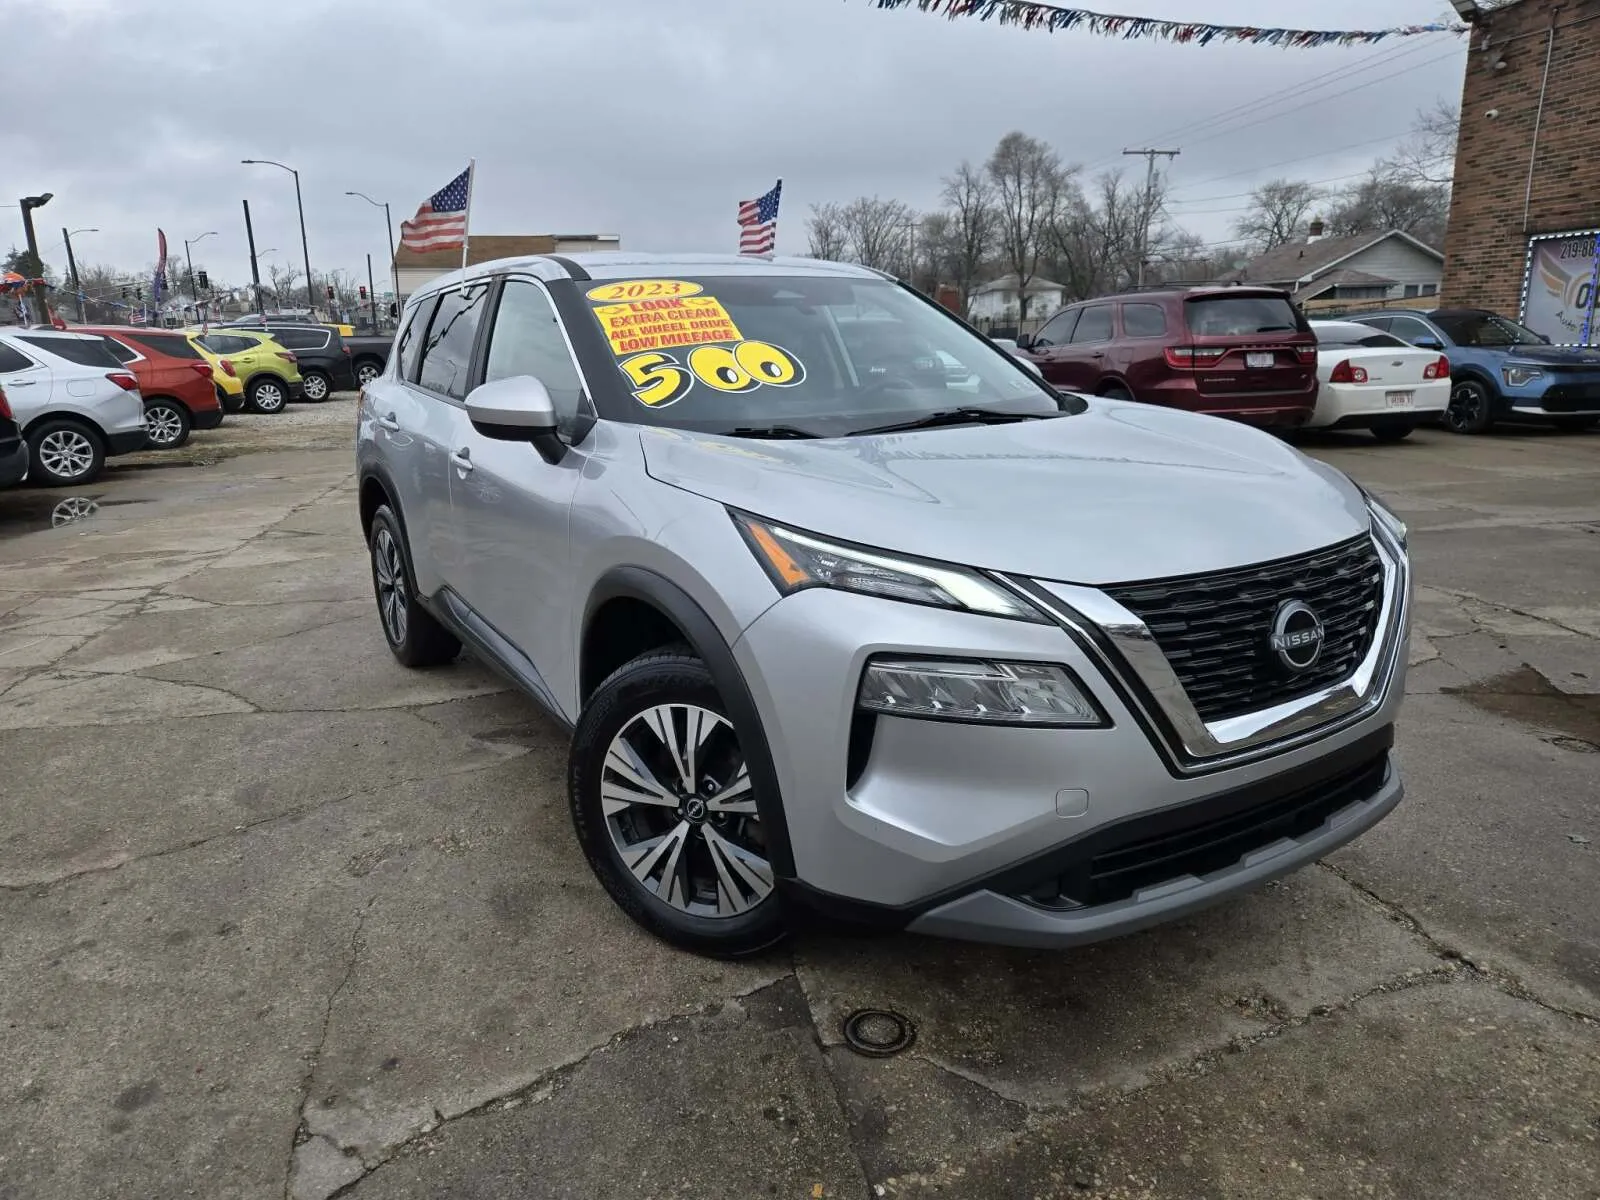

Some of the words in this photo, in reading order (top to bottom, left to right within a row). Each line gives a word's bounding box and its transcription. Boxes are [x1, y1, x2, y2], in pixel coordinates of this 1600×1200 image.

[608, 283, 680, 299] 2023
[629, 298, 686, 312] LOOK
[610, 312, 667, 328] EXTRA
[667, 307, 721, 320] CLEAN
[611, 329, 640, 341] ALL
[640, 322, 690, 336] WHEEL
[690, 319, 732, 331] DRIVE
[620, 335, 658, 352] LOW
[659, 329, 735, 346] MILEAGE
[619, 340, 807, 408] 500
[1273, 622, 1325, 649] NISSAN
